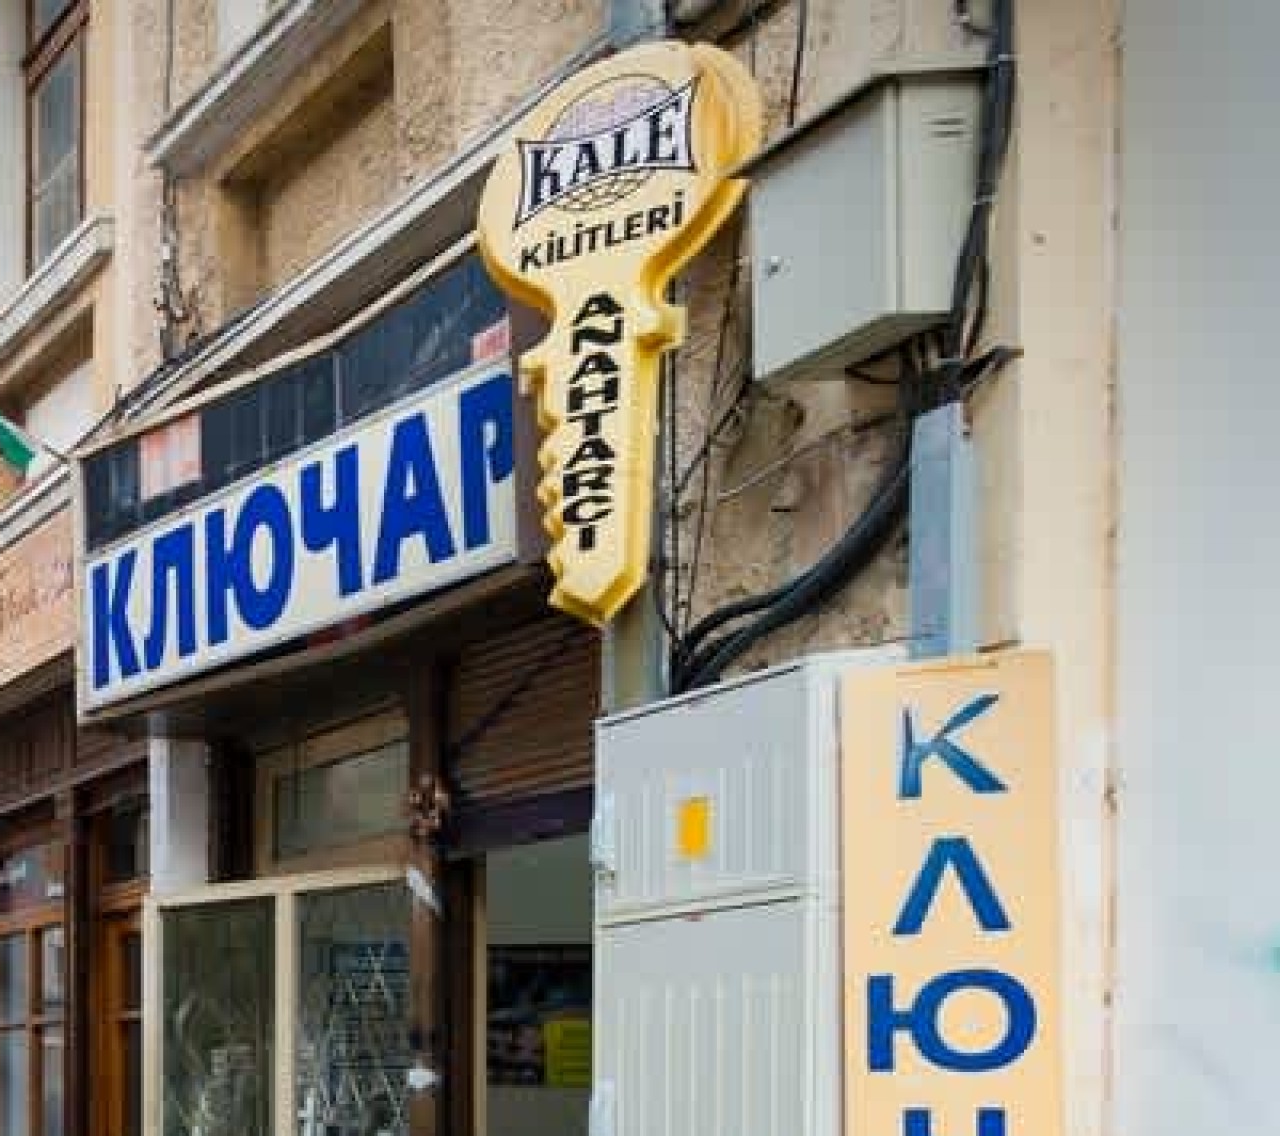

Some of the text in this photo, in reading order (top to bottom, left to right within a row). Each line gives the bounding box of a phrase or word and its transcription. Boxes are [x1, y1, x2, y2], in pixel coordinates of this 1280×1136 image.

[524, 97, 684, 208] KALE
[91, 372, 514, 693] КЛЮЧАР
[561, 291, 625, 550] ANAHTARCI
